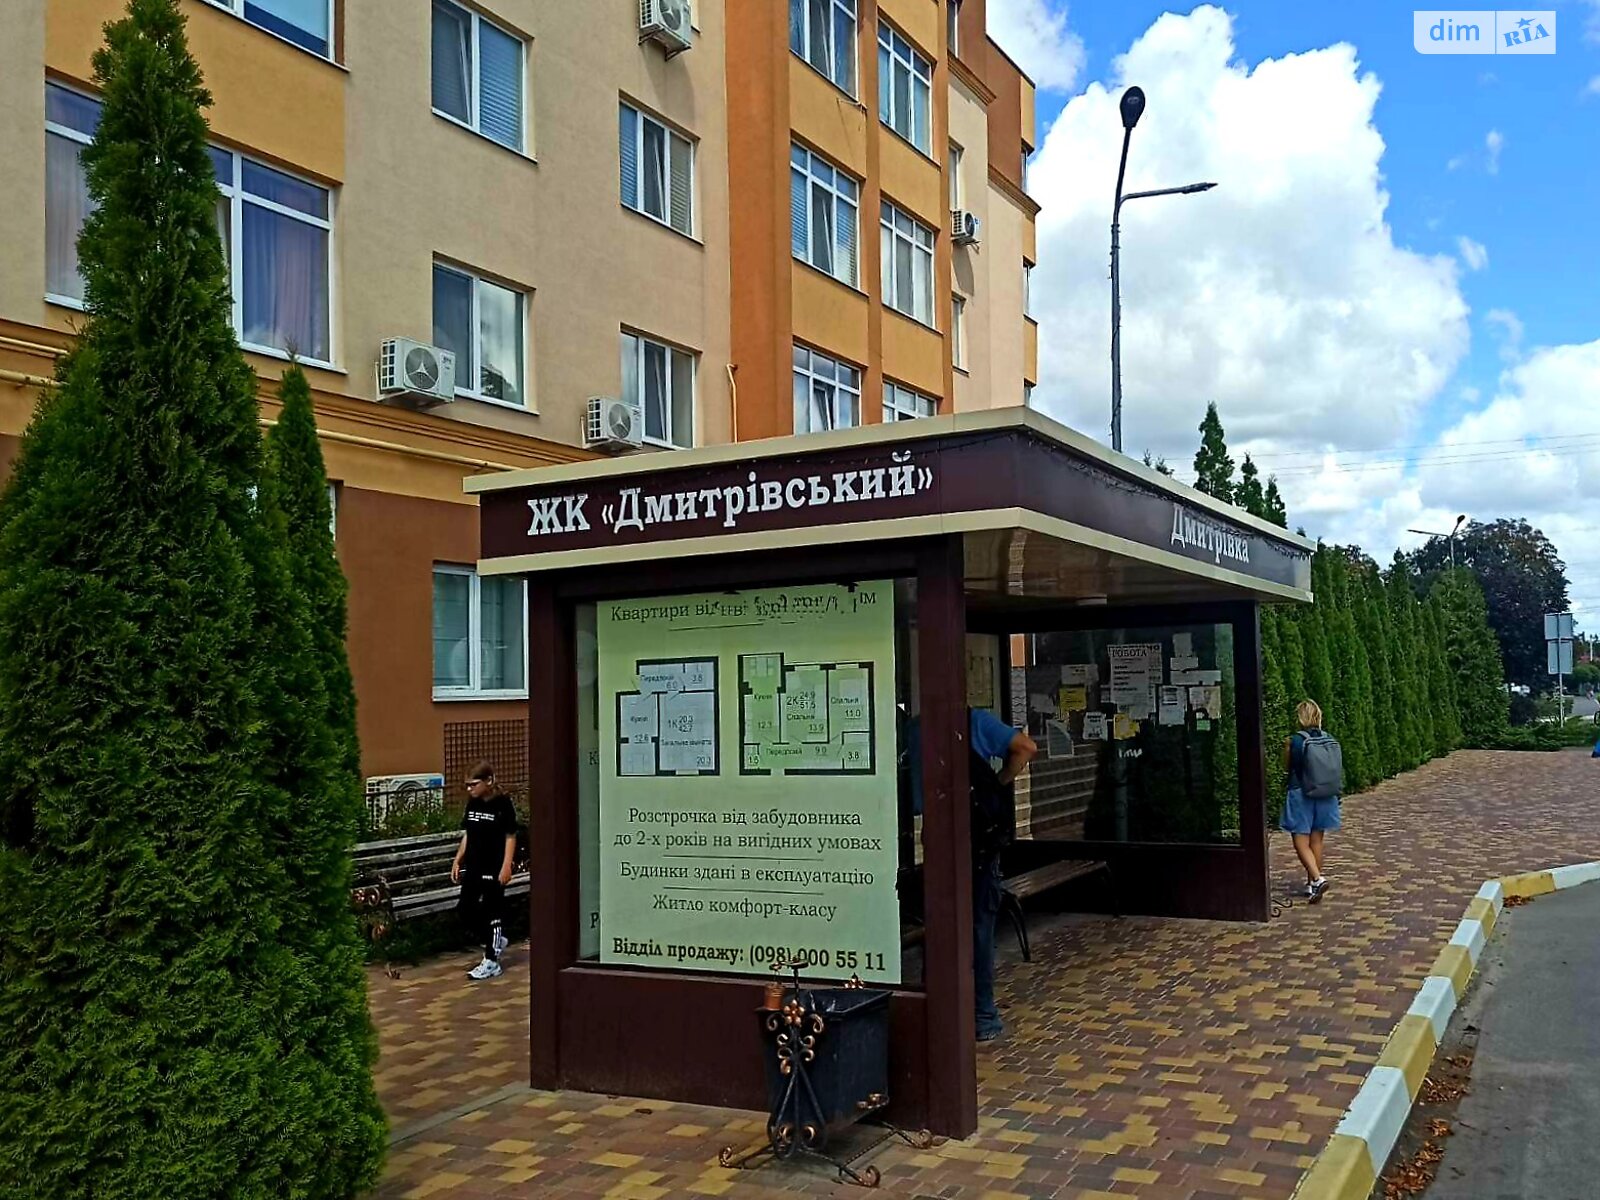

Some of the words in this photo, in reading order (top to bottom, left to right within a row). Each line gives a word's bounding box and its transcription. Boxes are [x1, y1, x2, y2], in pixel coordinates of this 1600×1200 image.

[526, 493, 591, 536] ЖК
[601, 450, 934, 534] «Дмитрівський»
[1171, 503, 1249, 564] Дмитрівка
[611, 606, 690, 623] Квартири
[628, 808, 717, 827] Розстрочка
[723, 808, 747, 826] від
[752, 809, 862, 830] забудовника
[613, 833, 632, 847] до
[636, 831, 661, 846] 2-х
[665, 831, 707, 850] років
[713, 834, 732, 848] на
[738, 833, 812, 850] вигідних
[817, 837, 882, 853] умовах
[620, 861, 689, 881] Будинки
[693, 862, 735, 882] здані
[742, 868, 751, 881] в
[755, 867, 874, 888] експлуатацію
[652, 894, 704, 912] Житло
[709, 897, 837, 921] комфорт-класу
[612, 937, 663, 957] Відділ
[667, 942, 744, 965] продажу:
[798, 948, 829, 967] 000
[836, 951, 858, 969] 55
[865, 952, 886, 971] 11
